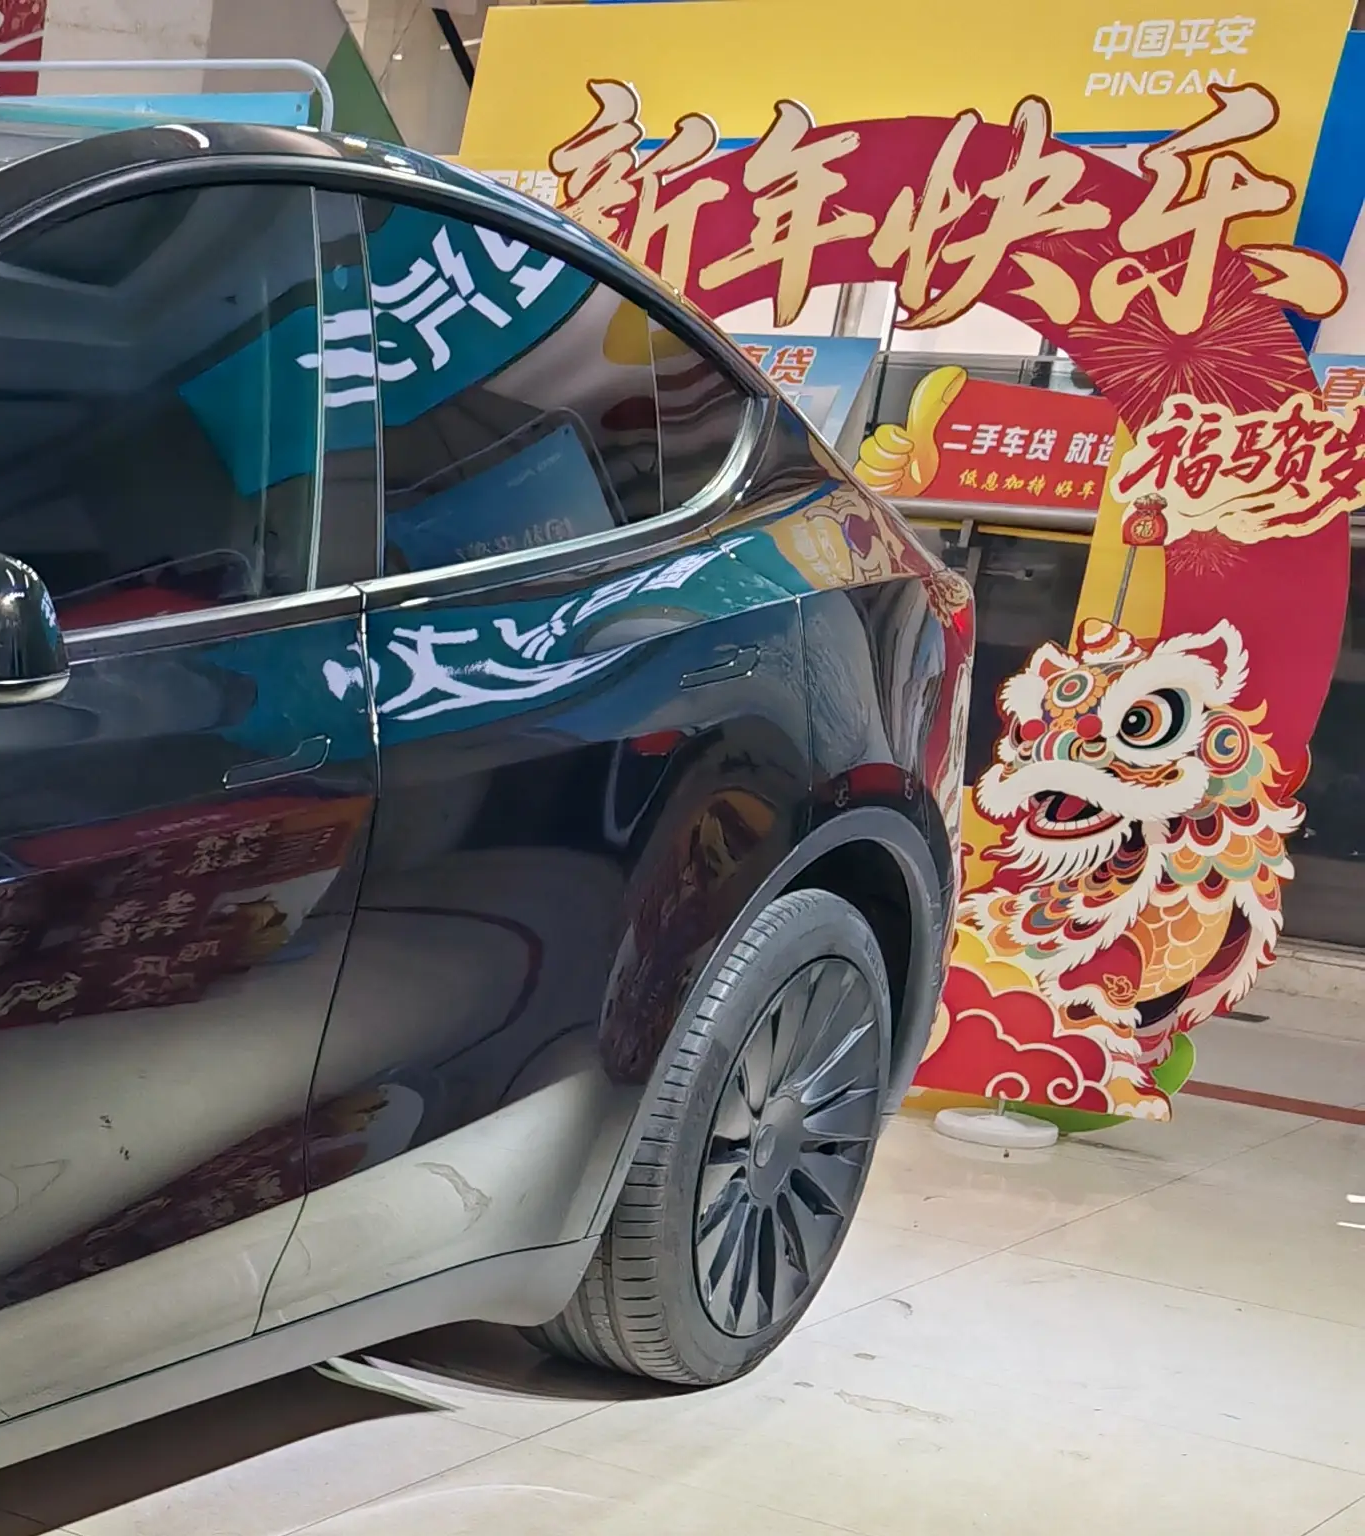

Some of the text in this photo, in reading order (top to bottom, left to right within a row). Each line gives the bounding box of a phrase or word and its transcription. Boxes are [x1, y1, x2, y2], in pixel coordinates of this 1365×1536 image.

[1093, 15, 1256, 61] 中国平安
[550, 77, 1349, 334] 新年快乐
[942, 423, 1059, 462] 二手车贷
[959, 468, 1096, 501] 低息加持 好车
